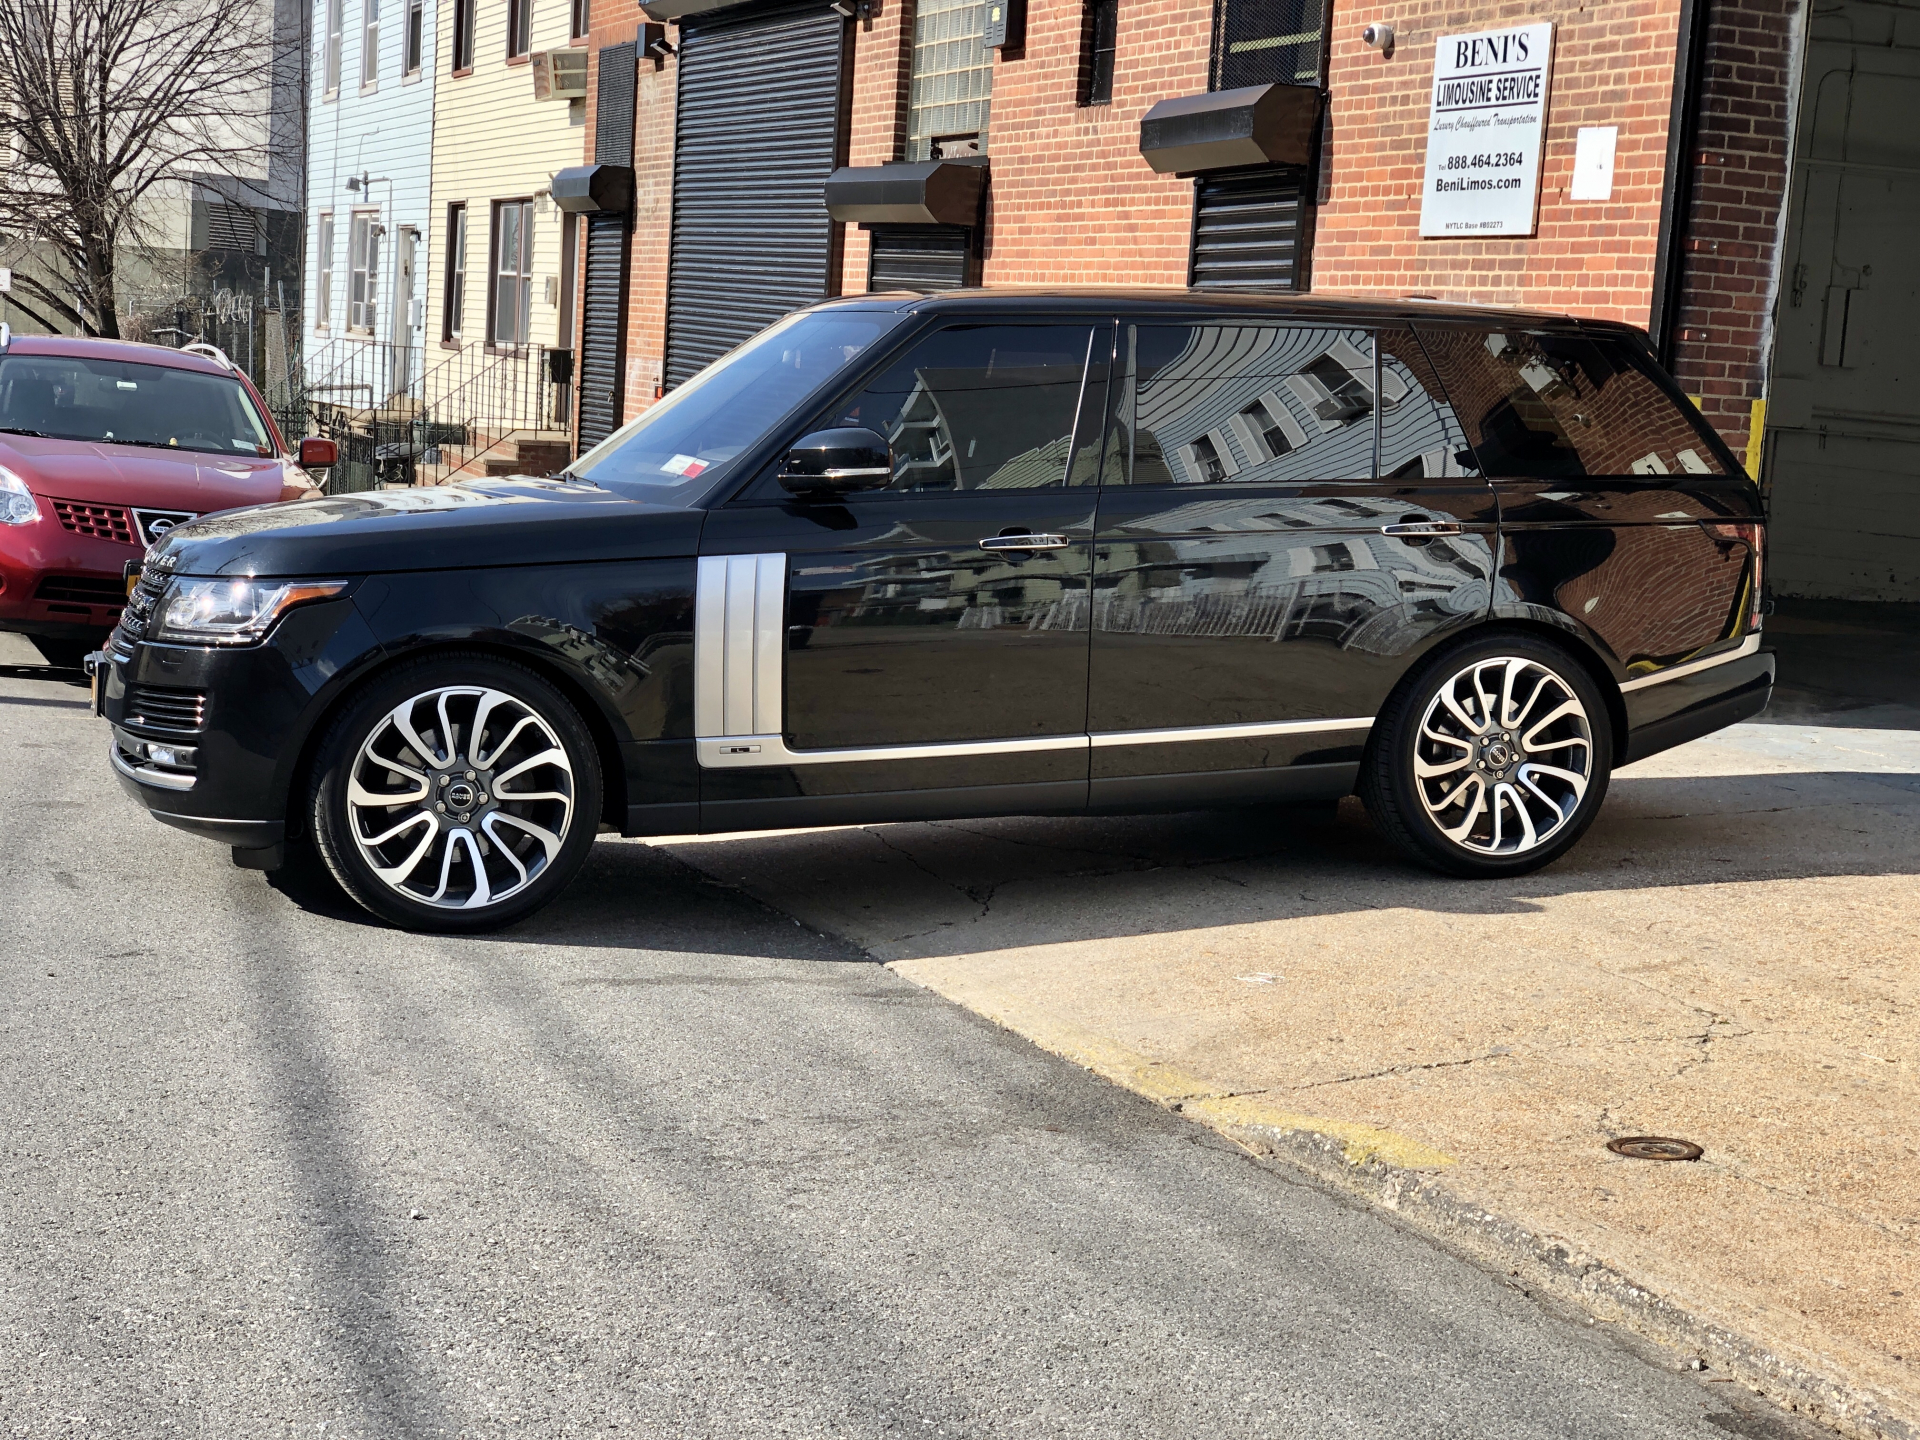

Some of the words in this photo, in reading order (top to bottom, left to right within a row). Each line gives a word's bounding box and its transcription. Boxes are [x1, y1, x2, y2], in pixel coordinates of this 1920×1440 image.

[1454, 32, 1530, 69] BENI'S
[1436, 79, 1494, 107] LIMOUSINE
[1495, 74, 1541, 102] SERVICE
[1433, 118, 1454, 132] Luxury
[1455, 114, 1492, 132] Chauffeured
[1493, 112, 1538, 129] Transportation
[1447, 152, 1523, 170] 888.464.2364
[1436, 177, 1522, 192] BeniLimos.com
[1445, 222, 1464, 230] NYTLC
[1464, 221, 1479, 229] Base
